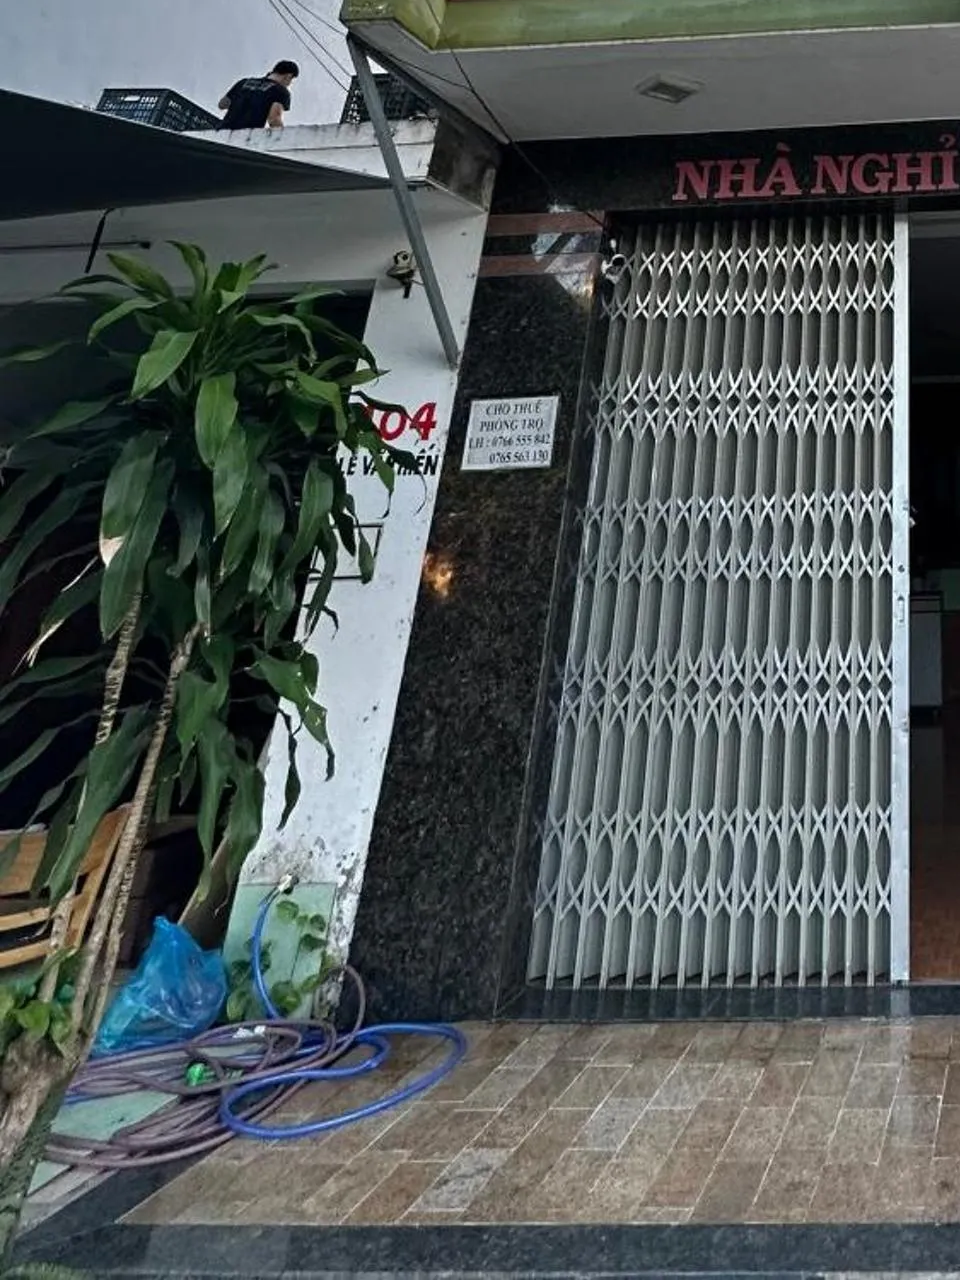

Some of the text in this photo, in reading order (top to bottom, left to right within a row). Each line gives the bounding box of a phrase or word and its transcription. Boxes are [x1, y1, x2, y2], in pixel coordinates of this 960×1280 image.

[671, 142, 801, 201] NHÀ
[810, 134, 960, 194] NGHỈ
[486, 400, 541, 415] CHO THUÊ
[480, 419, 544, 432] PHÒNG TRỌ
[491, 436, 514, 447] 0766
[516, 435, 532, 446] 555
[534, 433, 551, 444] 842
[489, 451, 512, 464] 0765
[513, 451, 530, 462] 563
